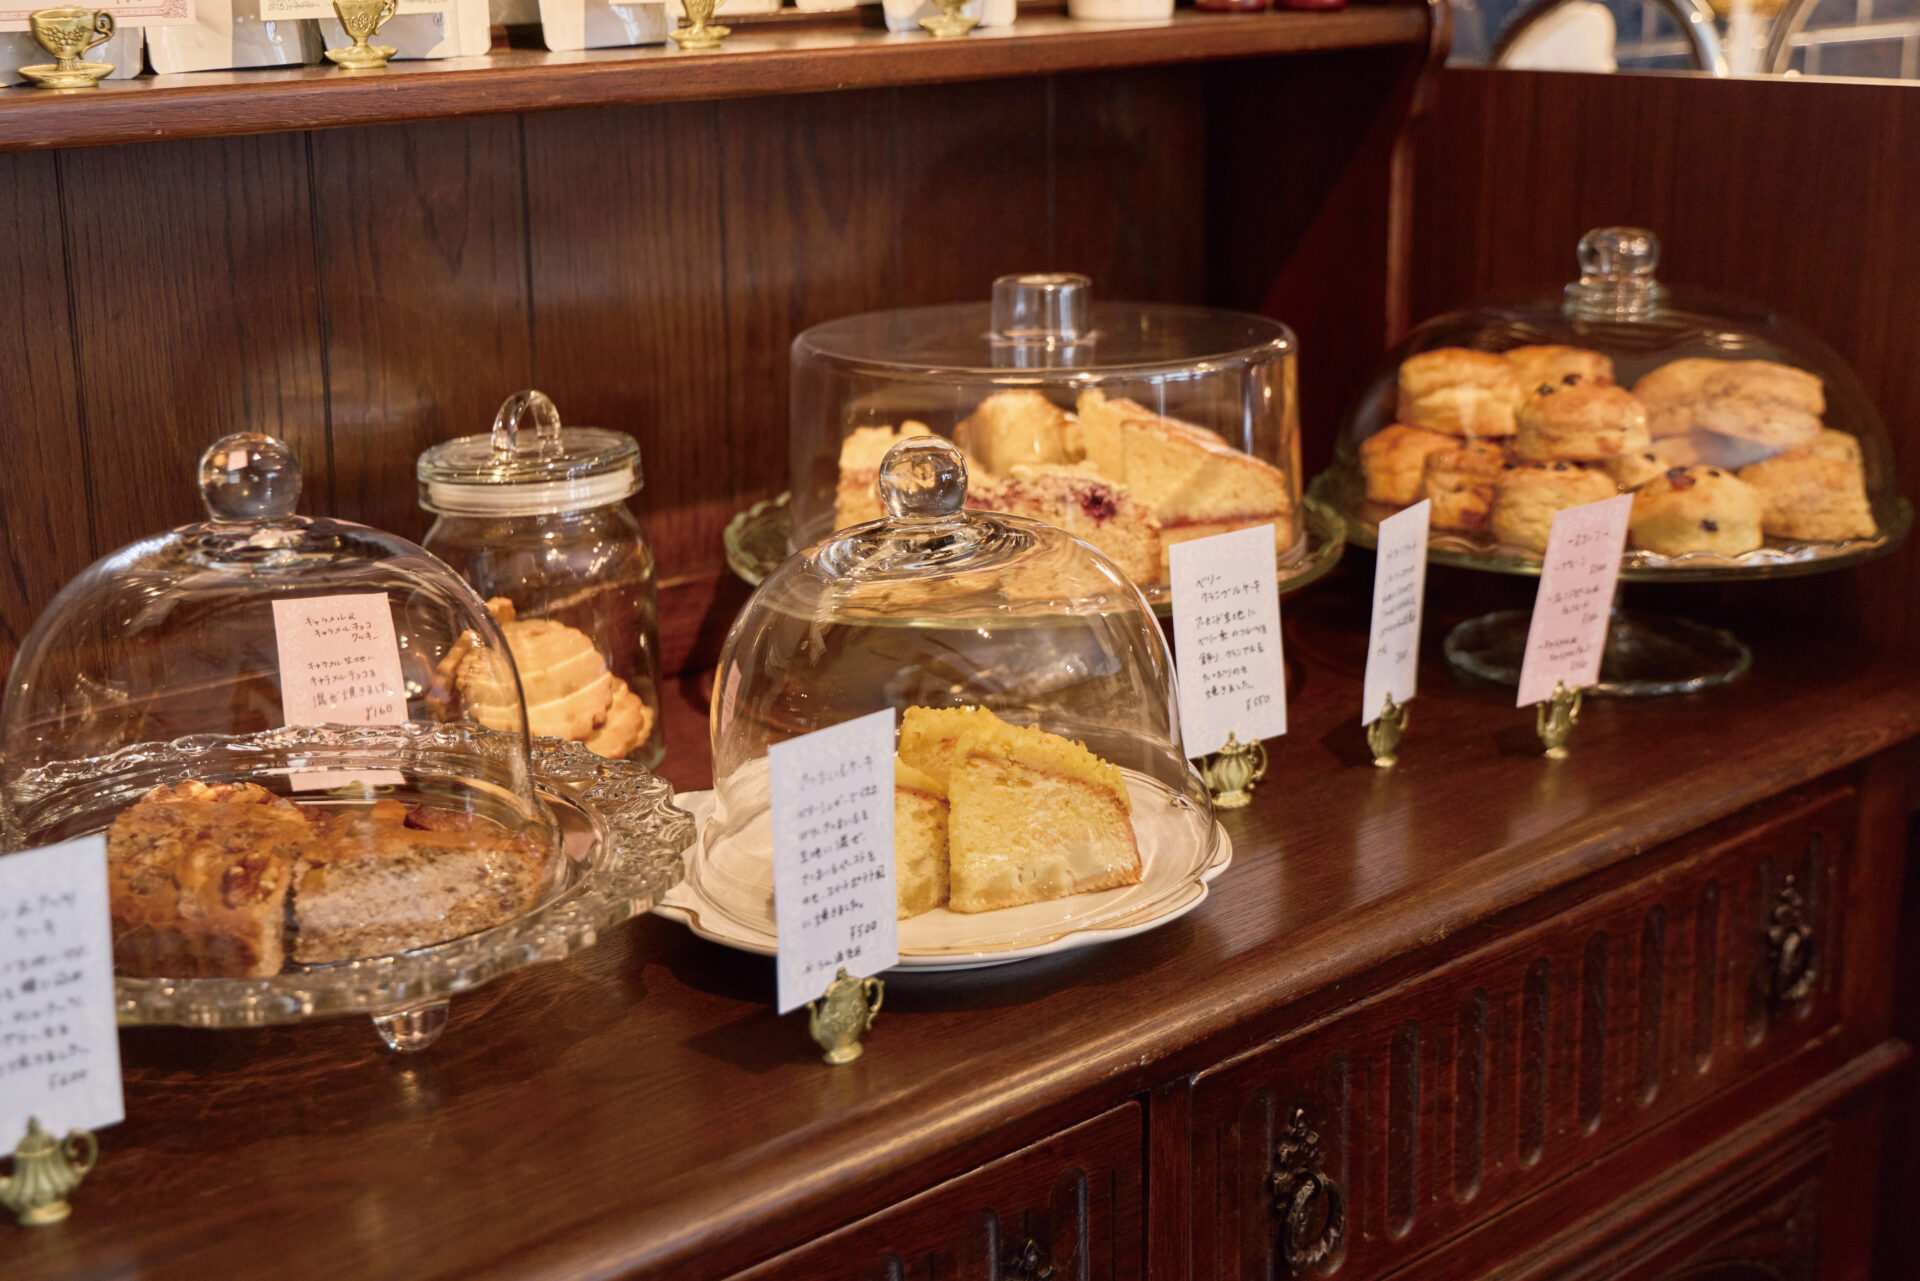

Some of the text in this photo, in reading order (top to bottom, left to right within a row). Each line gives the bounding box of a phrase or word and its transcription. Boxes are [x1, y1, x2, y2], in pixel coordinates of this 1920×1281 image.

[1195, 573, 1222, 589] ベリー
[1200, 579, 1261, 603] クランブルケーキ
[314, 621, 372, 637] キャラメルチョコ
[352, 632, 378, 642] クッキー
[365, 704, 393, 722] ¥160
[849, 920, 877, 943] ¥500
